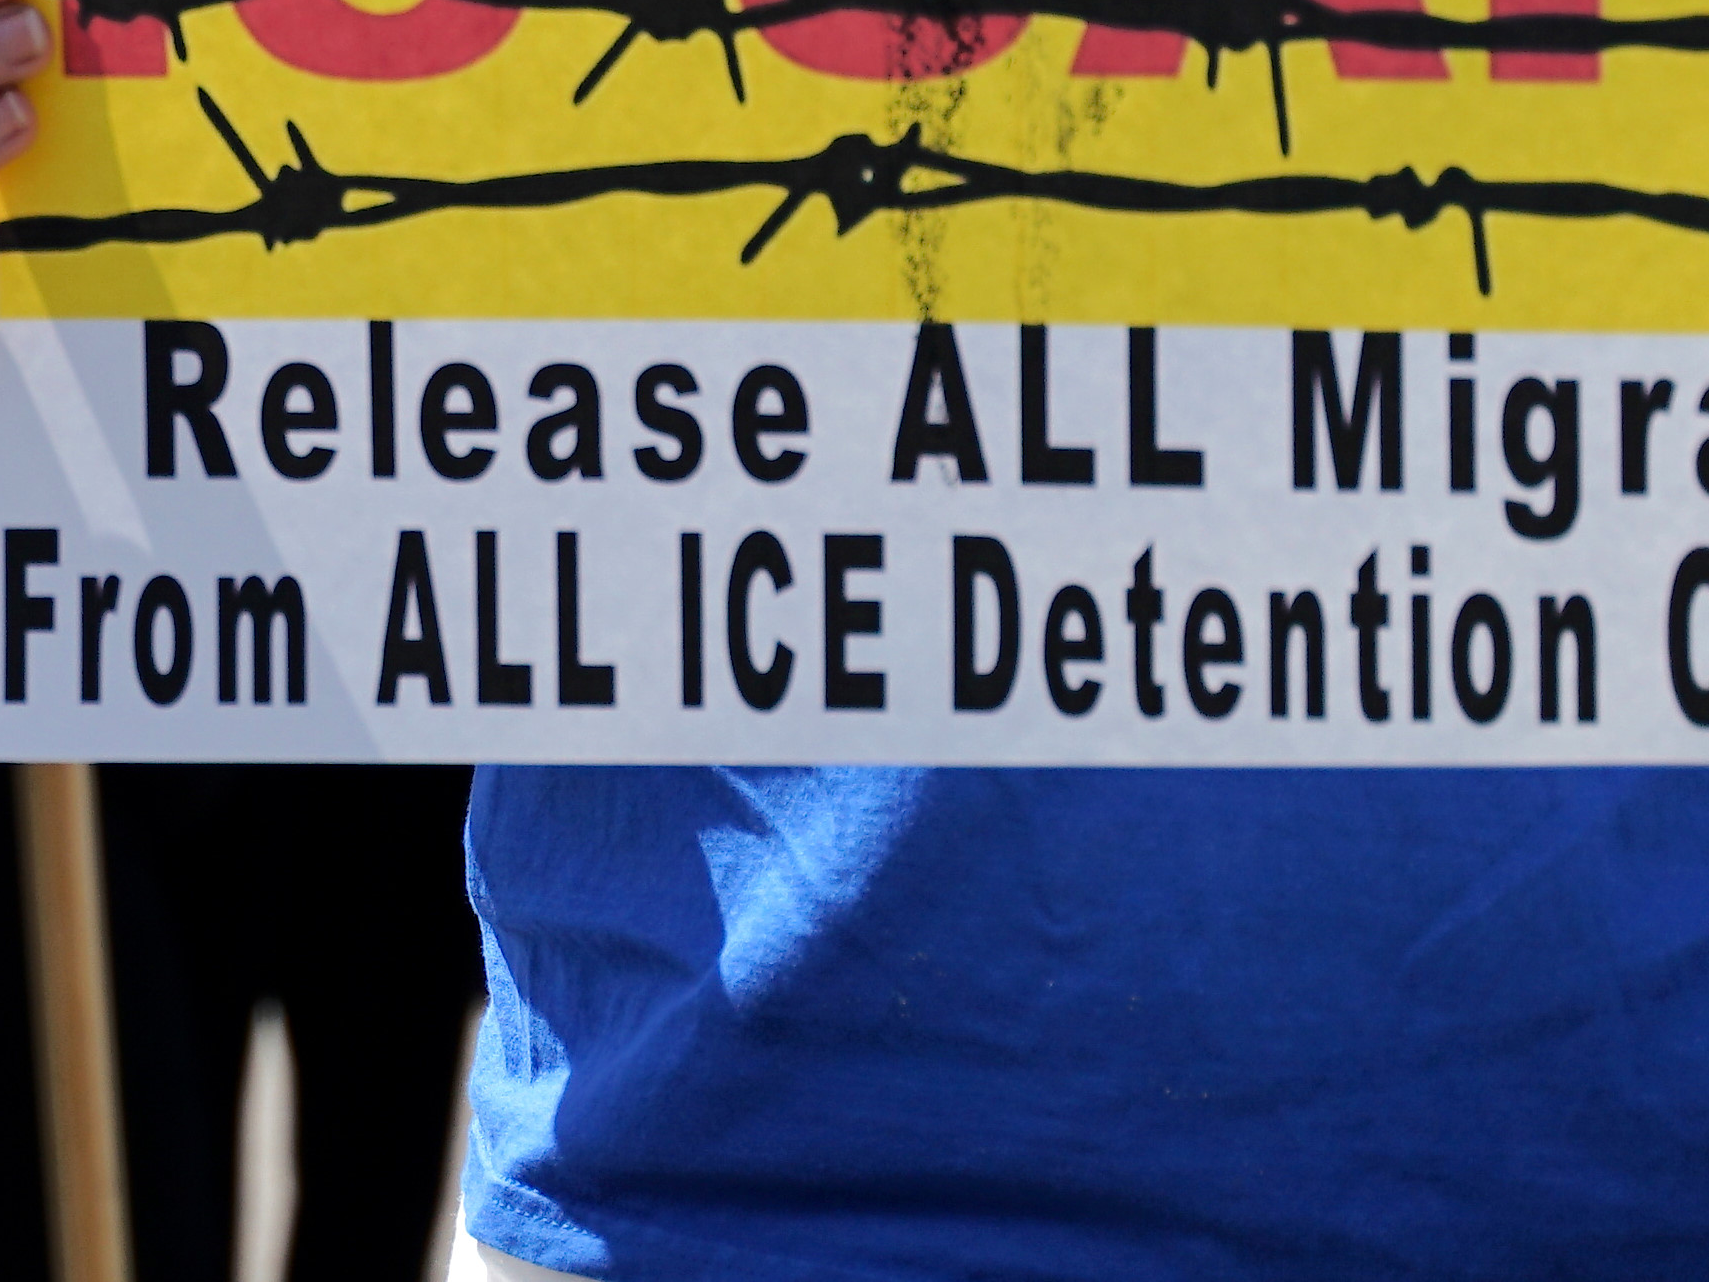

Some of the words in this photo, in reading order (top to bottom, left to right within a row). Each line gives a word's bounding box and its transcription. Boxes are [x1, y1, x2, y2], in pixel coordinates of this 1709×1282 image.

[143, 318, 810, 480] Release
[891, 320, 1204, 486] ALL
[2, 527, 308, 706] From
[377, 529, 617, 707] ALL
[681, 530, 886, 712] ICE
[952, 534, 1598, 724] Detention
